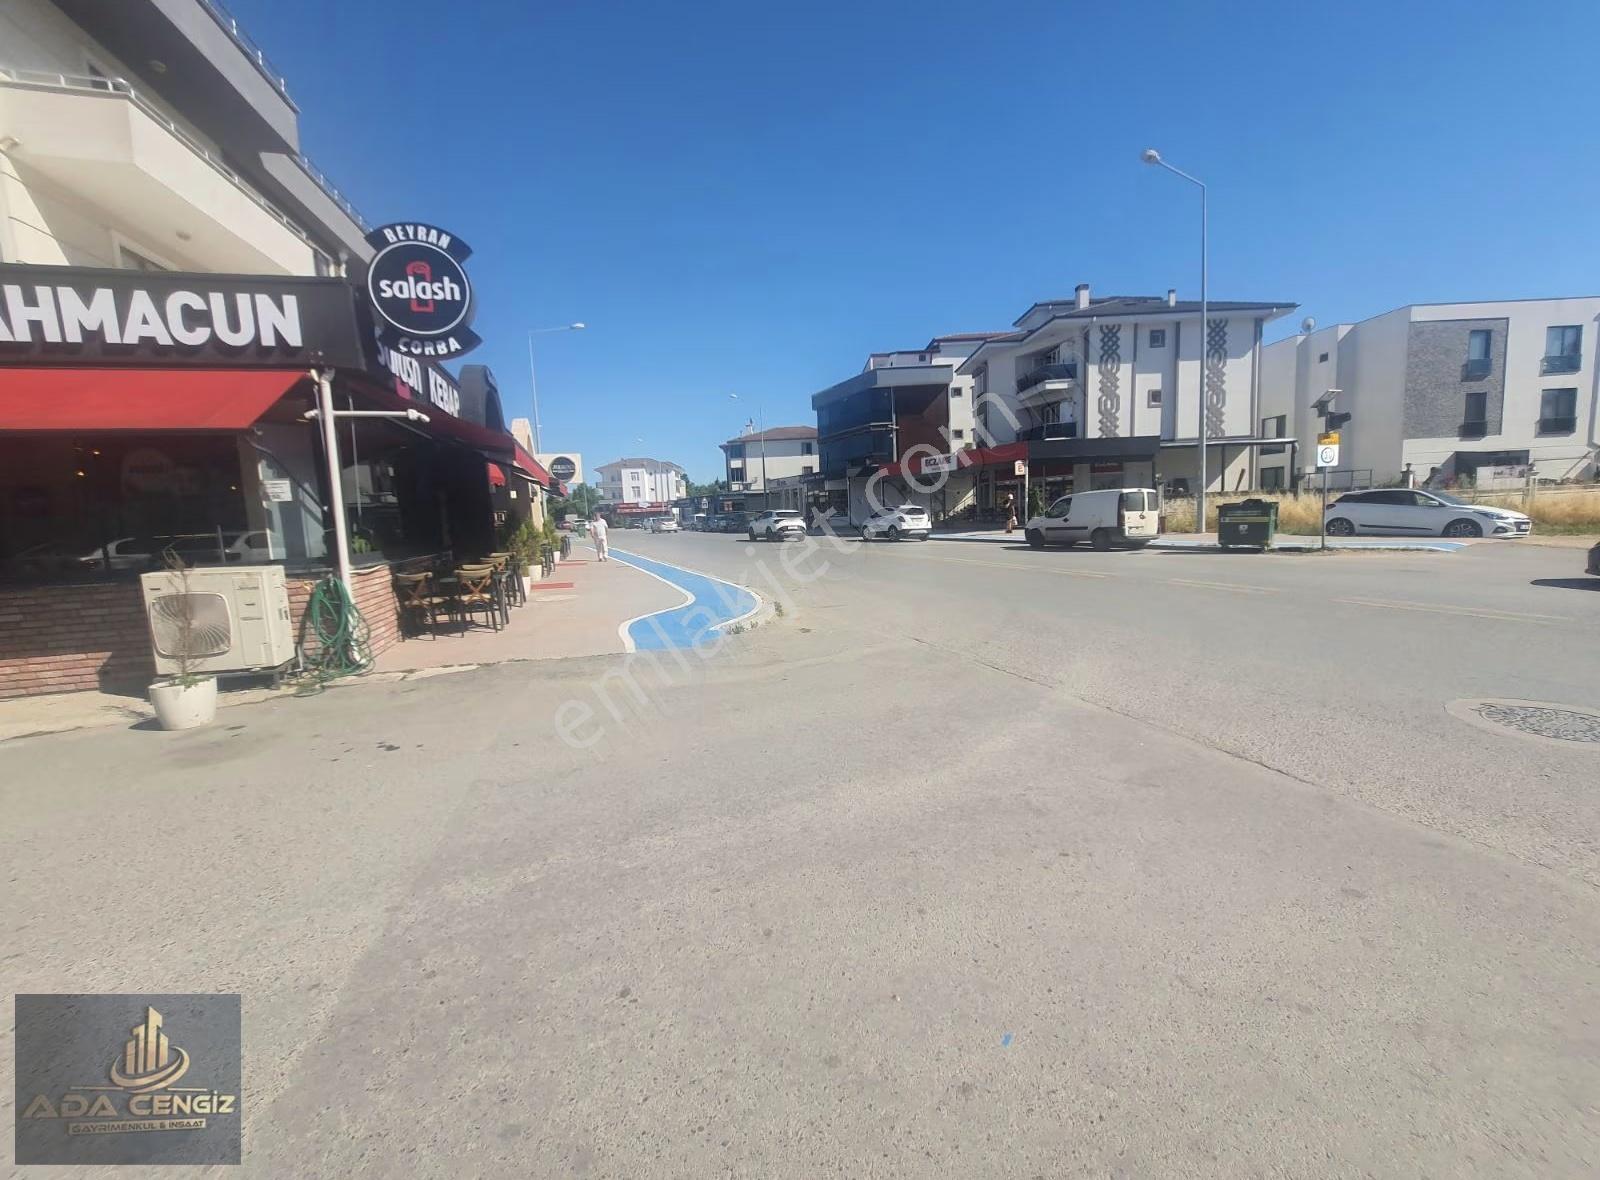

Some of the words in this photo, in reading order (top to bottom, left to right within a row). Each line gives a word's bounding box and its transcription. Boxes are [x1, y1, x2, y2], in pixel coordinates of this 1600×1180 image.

[383, 224, 451, 250] BEYRAN
[379, 275, 461, 301] salash
[0, 285, 303, 347] HMACUN
[427, 366, 460, 418] KEBAP
